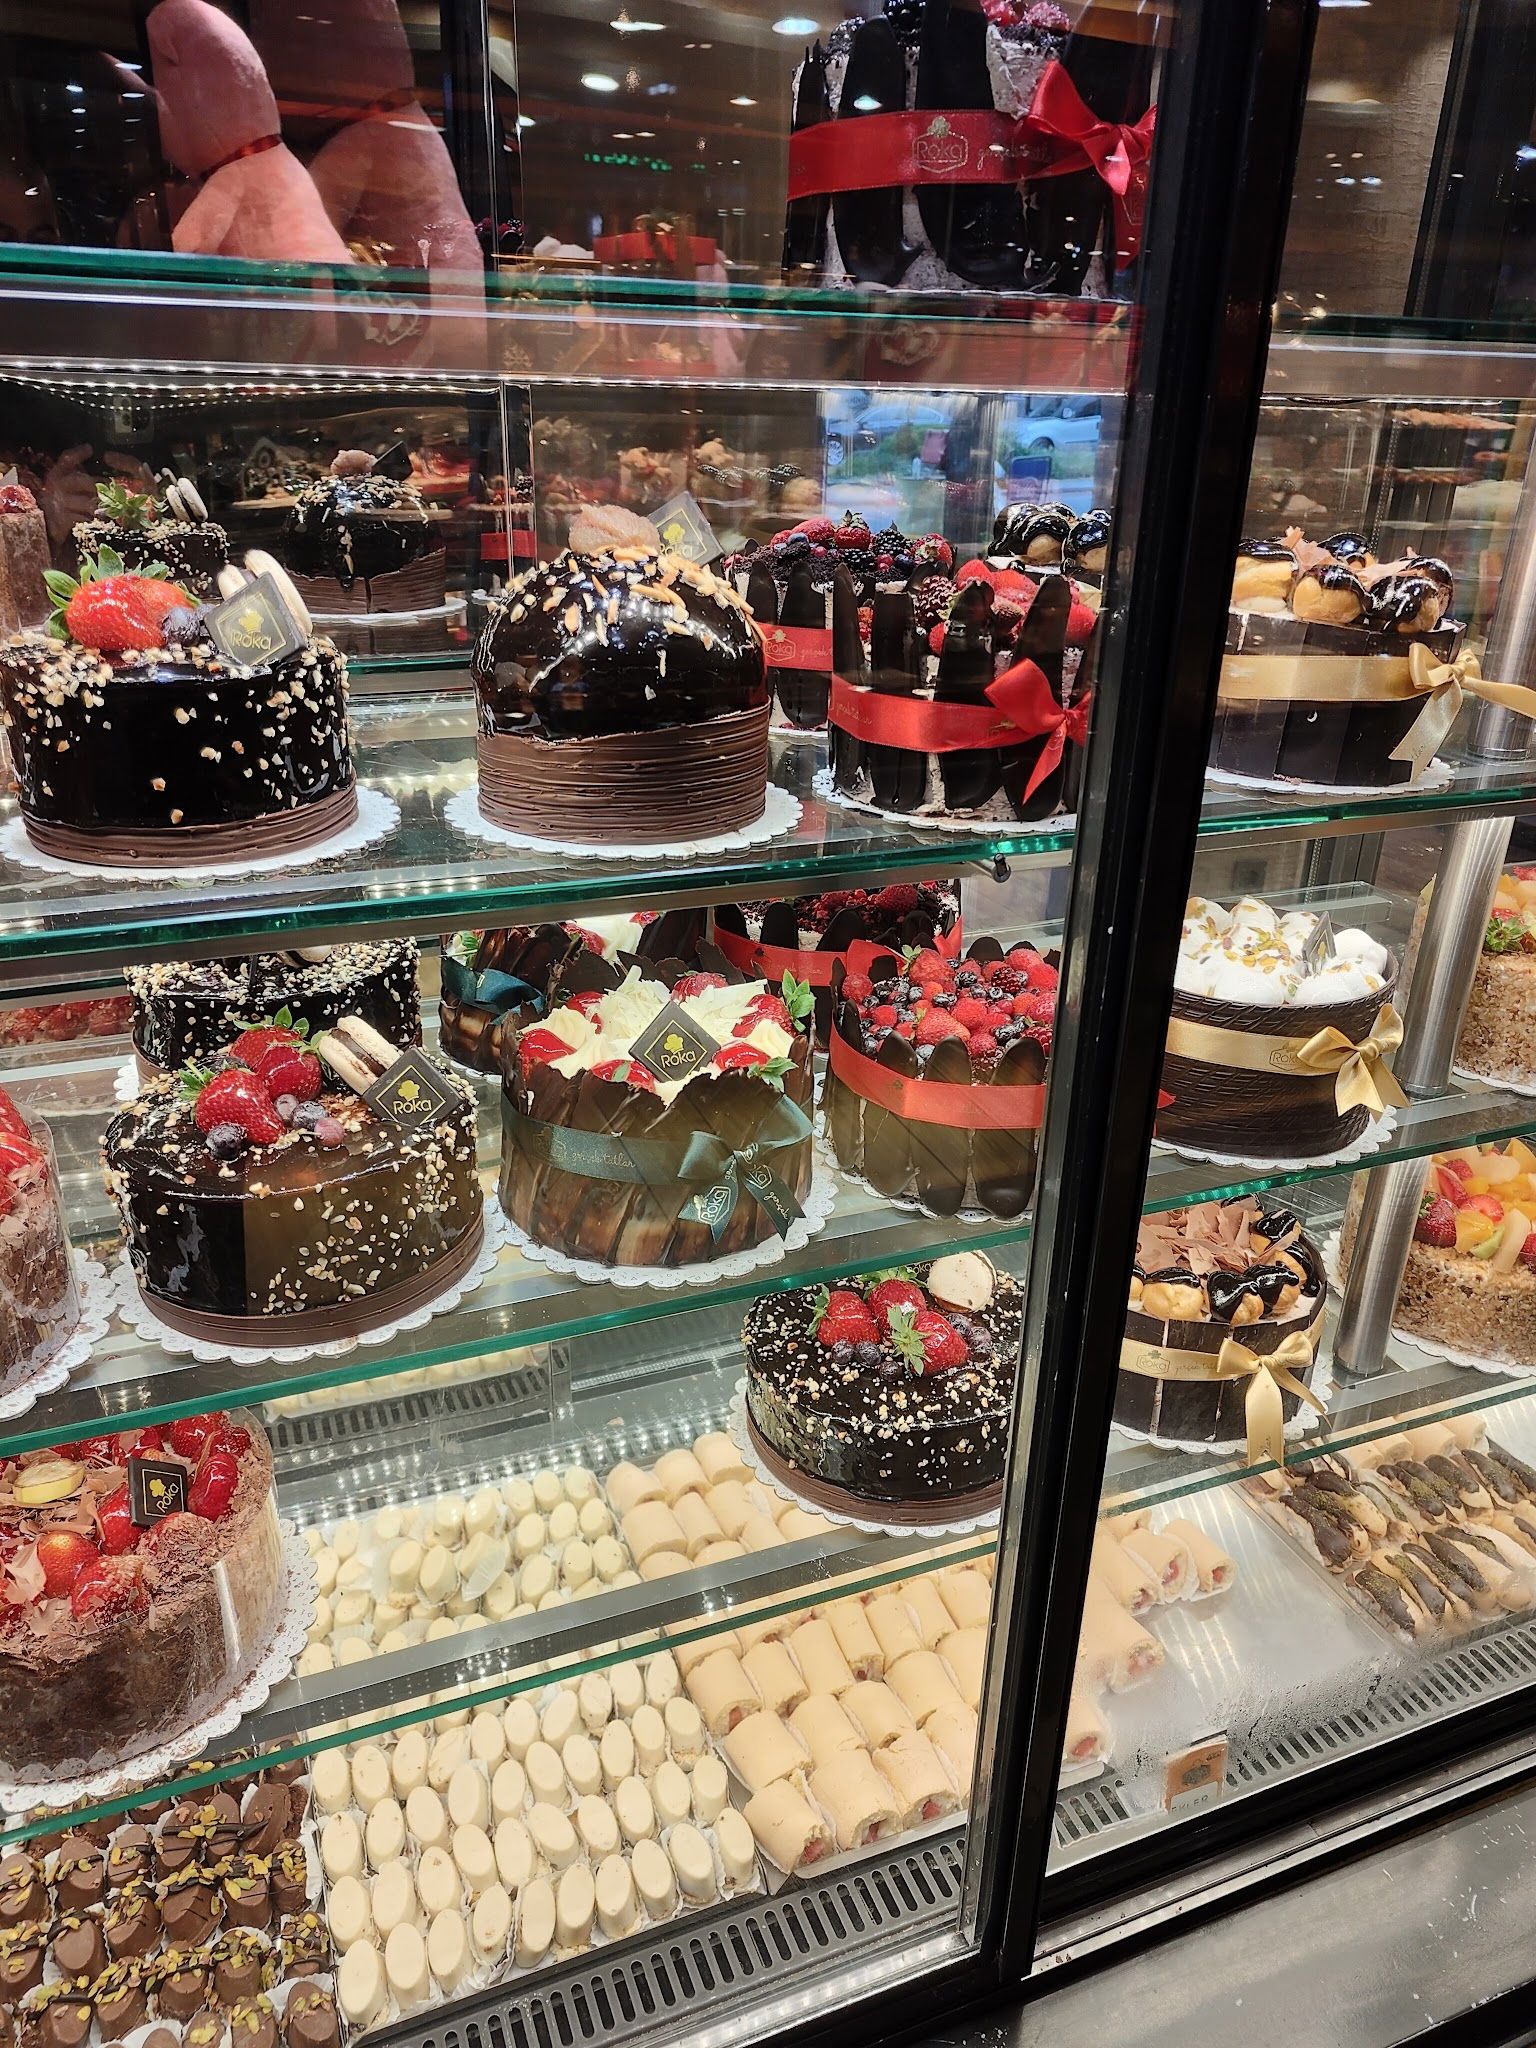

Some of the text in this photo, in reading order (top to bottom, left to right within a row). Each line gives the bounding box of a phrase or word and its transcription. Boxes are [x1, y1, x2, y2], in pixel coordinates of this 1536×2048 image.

[916, 140, 963, 160] Roka
[231, 631, 272, 650] Roka
[765, 641, 793, 656] Roka
[660, 1050, 697, 1069] Roka
[392, 1098, 432, 1115] Roka
[701, 1190, 729, 1220] Roka
[156, 1482, 180, 1514] Roka
